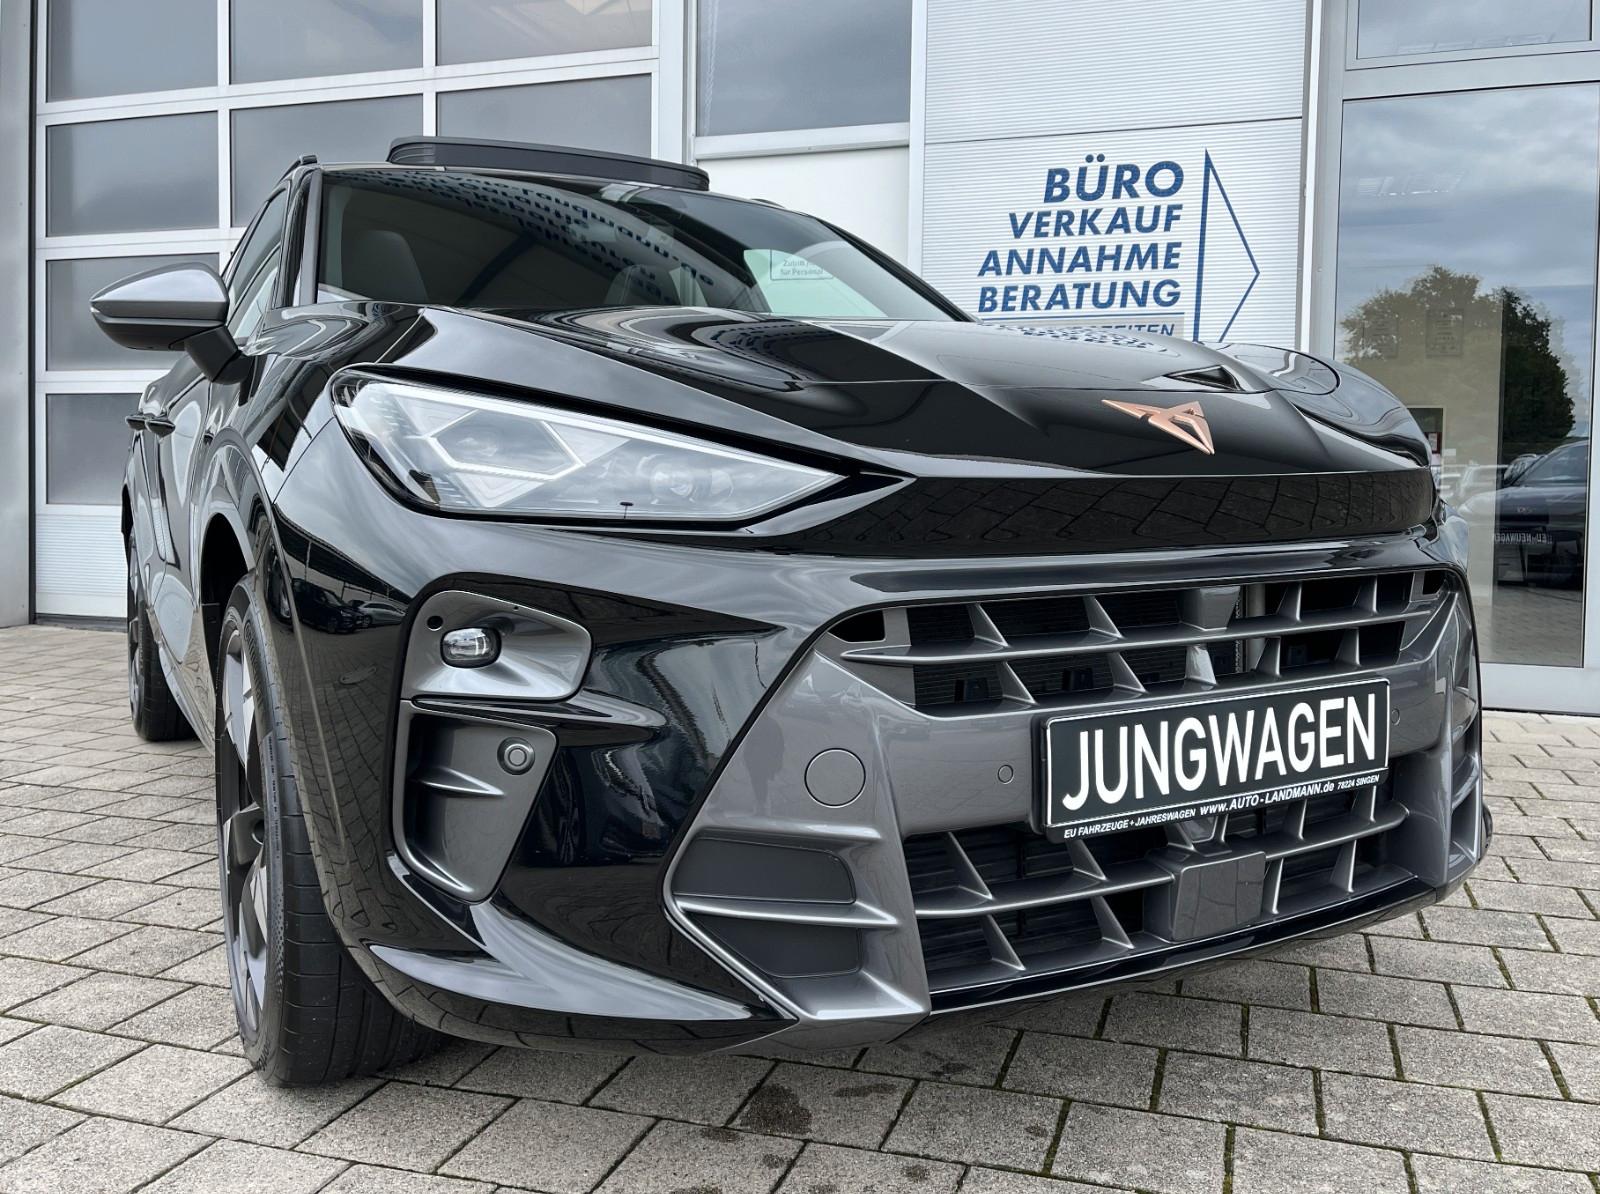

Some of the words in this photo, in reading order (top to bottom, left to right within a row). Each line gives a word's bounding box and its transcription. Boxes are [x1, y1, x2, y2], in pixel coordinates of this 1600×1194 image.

[1043, 153, 1185, 203] BÜRO
[1008, 204, 1183, 239] VERKAUF
[977, 241, 1183, 277] ANNAHME
[978, 279, 1182, 313] BERATUNG
[1062, 693, 1376, 811] JUNGWAGEN
[1355, 774, 1380, 787] SINGEN
